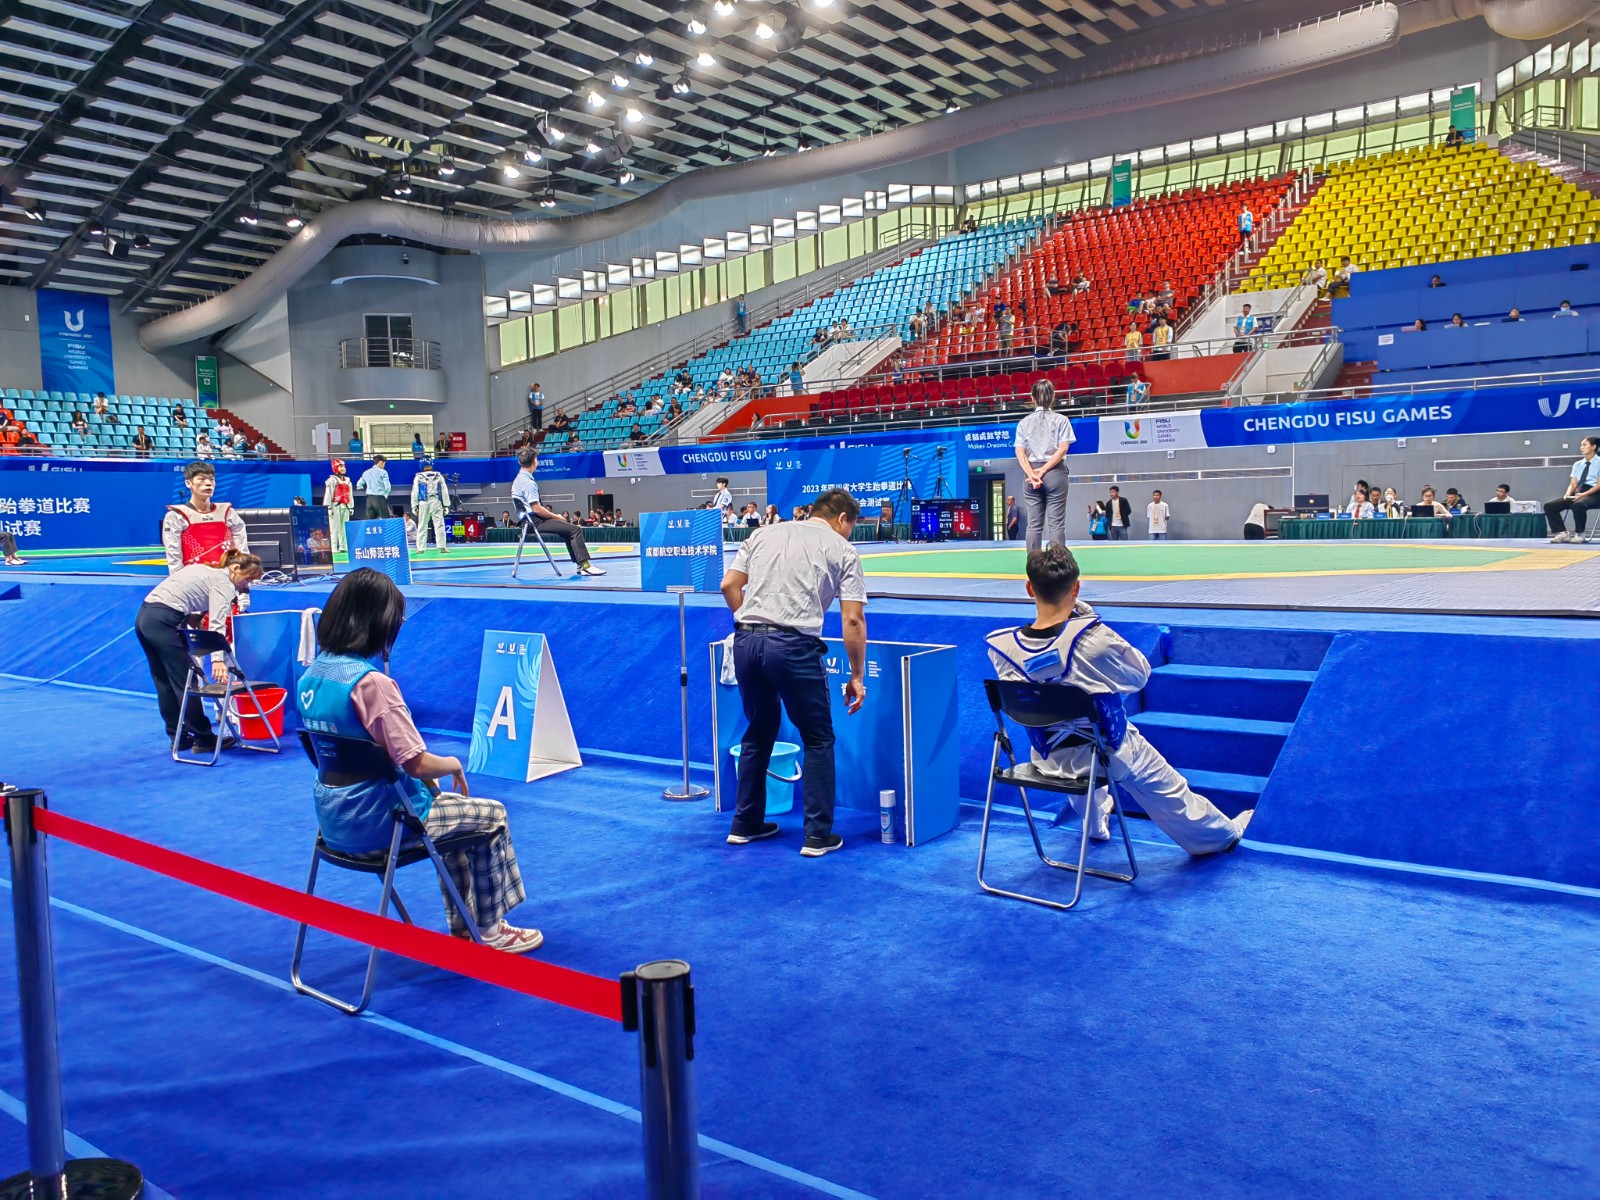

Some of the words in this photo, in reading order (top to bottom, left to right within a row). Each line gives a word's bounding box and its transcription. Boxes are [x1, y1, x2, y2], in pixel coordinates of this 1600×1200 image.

[1243, 412, 1330, 432] CHENGDU
[1335, 408, 1376, 426] FISU
[1382, 405, 1453, 423] GAMES
[986, 441, 1008, 449] Dreams
[682, 451, 728, 464] CHENGDU
[730, 449, 752, 461] FISU
[802, 485, 820, 493] 2023
[0, 519, 42, 537] 试赛
[445, 524, 452, 534] 2
[468, 524, 475, 533] 4
[354, 545, 401, 560] 乐山师范学院
[645, 544, 718, 558] 成都航空职业技术学院
[486, 685, 517, 740] A
